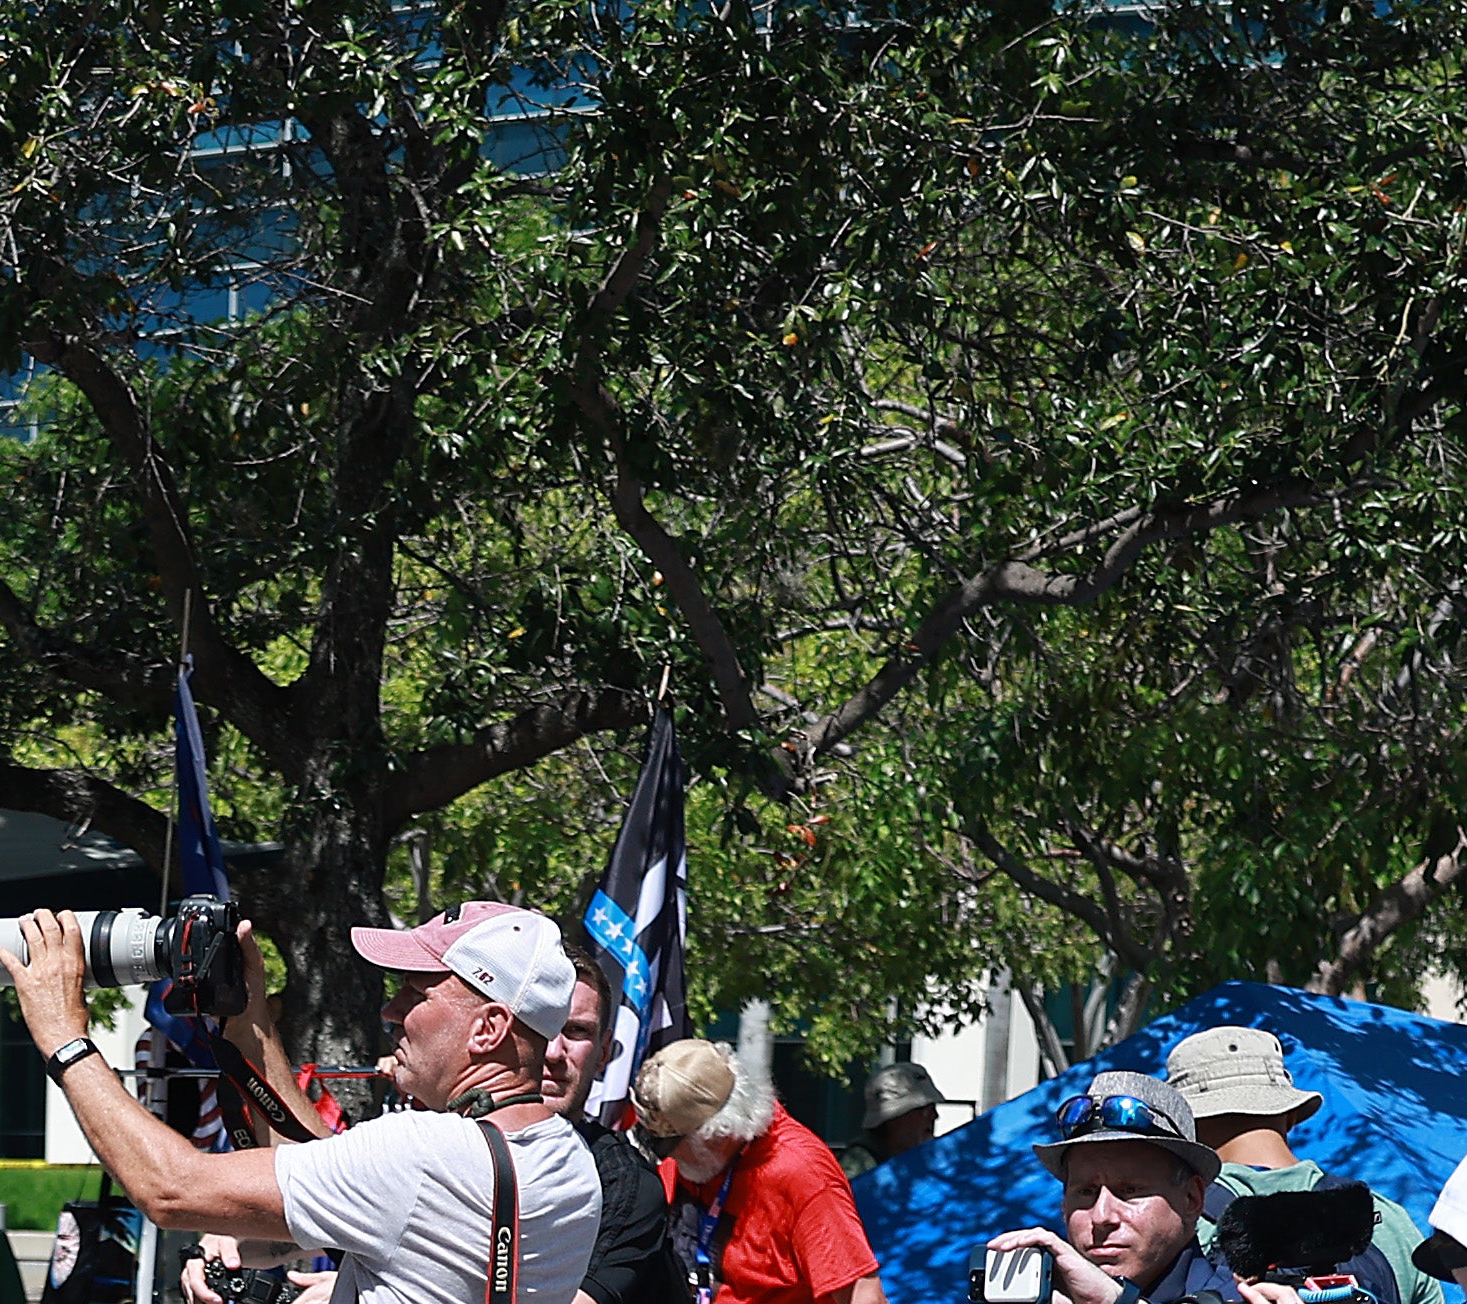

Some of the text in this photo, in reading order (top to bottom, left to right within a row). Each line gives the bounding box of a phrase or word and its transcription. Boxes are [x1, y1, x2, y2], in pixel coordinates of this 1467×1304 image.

[471, 967, 496, 987] 7.62
[246, 1075, 286, 1123] Canon
[495, 1226, 512, 1293] Canon
